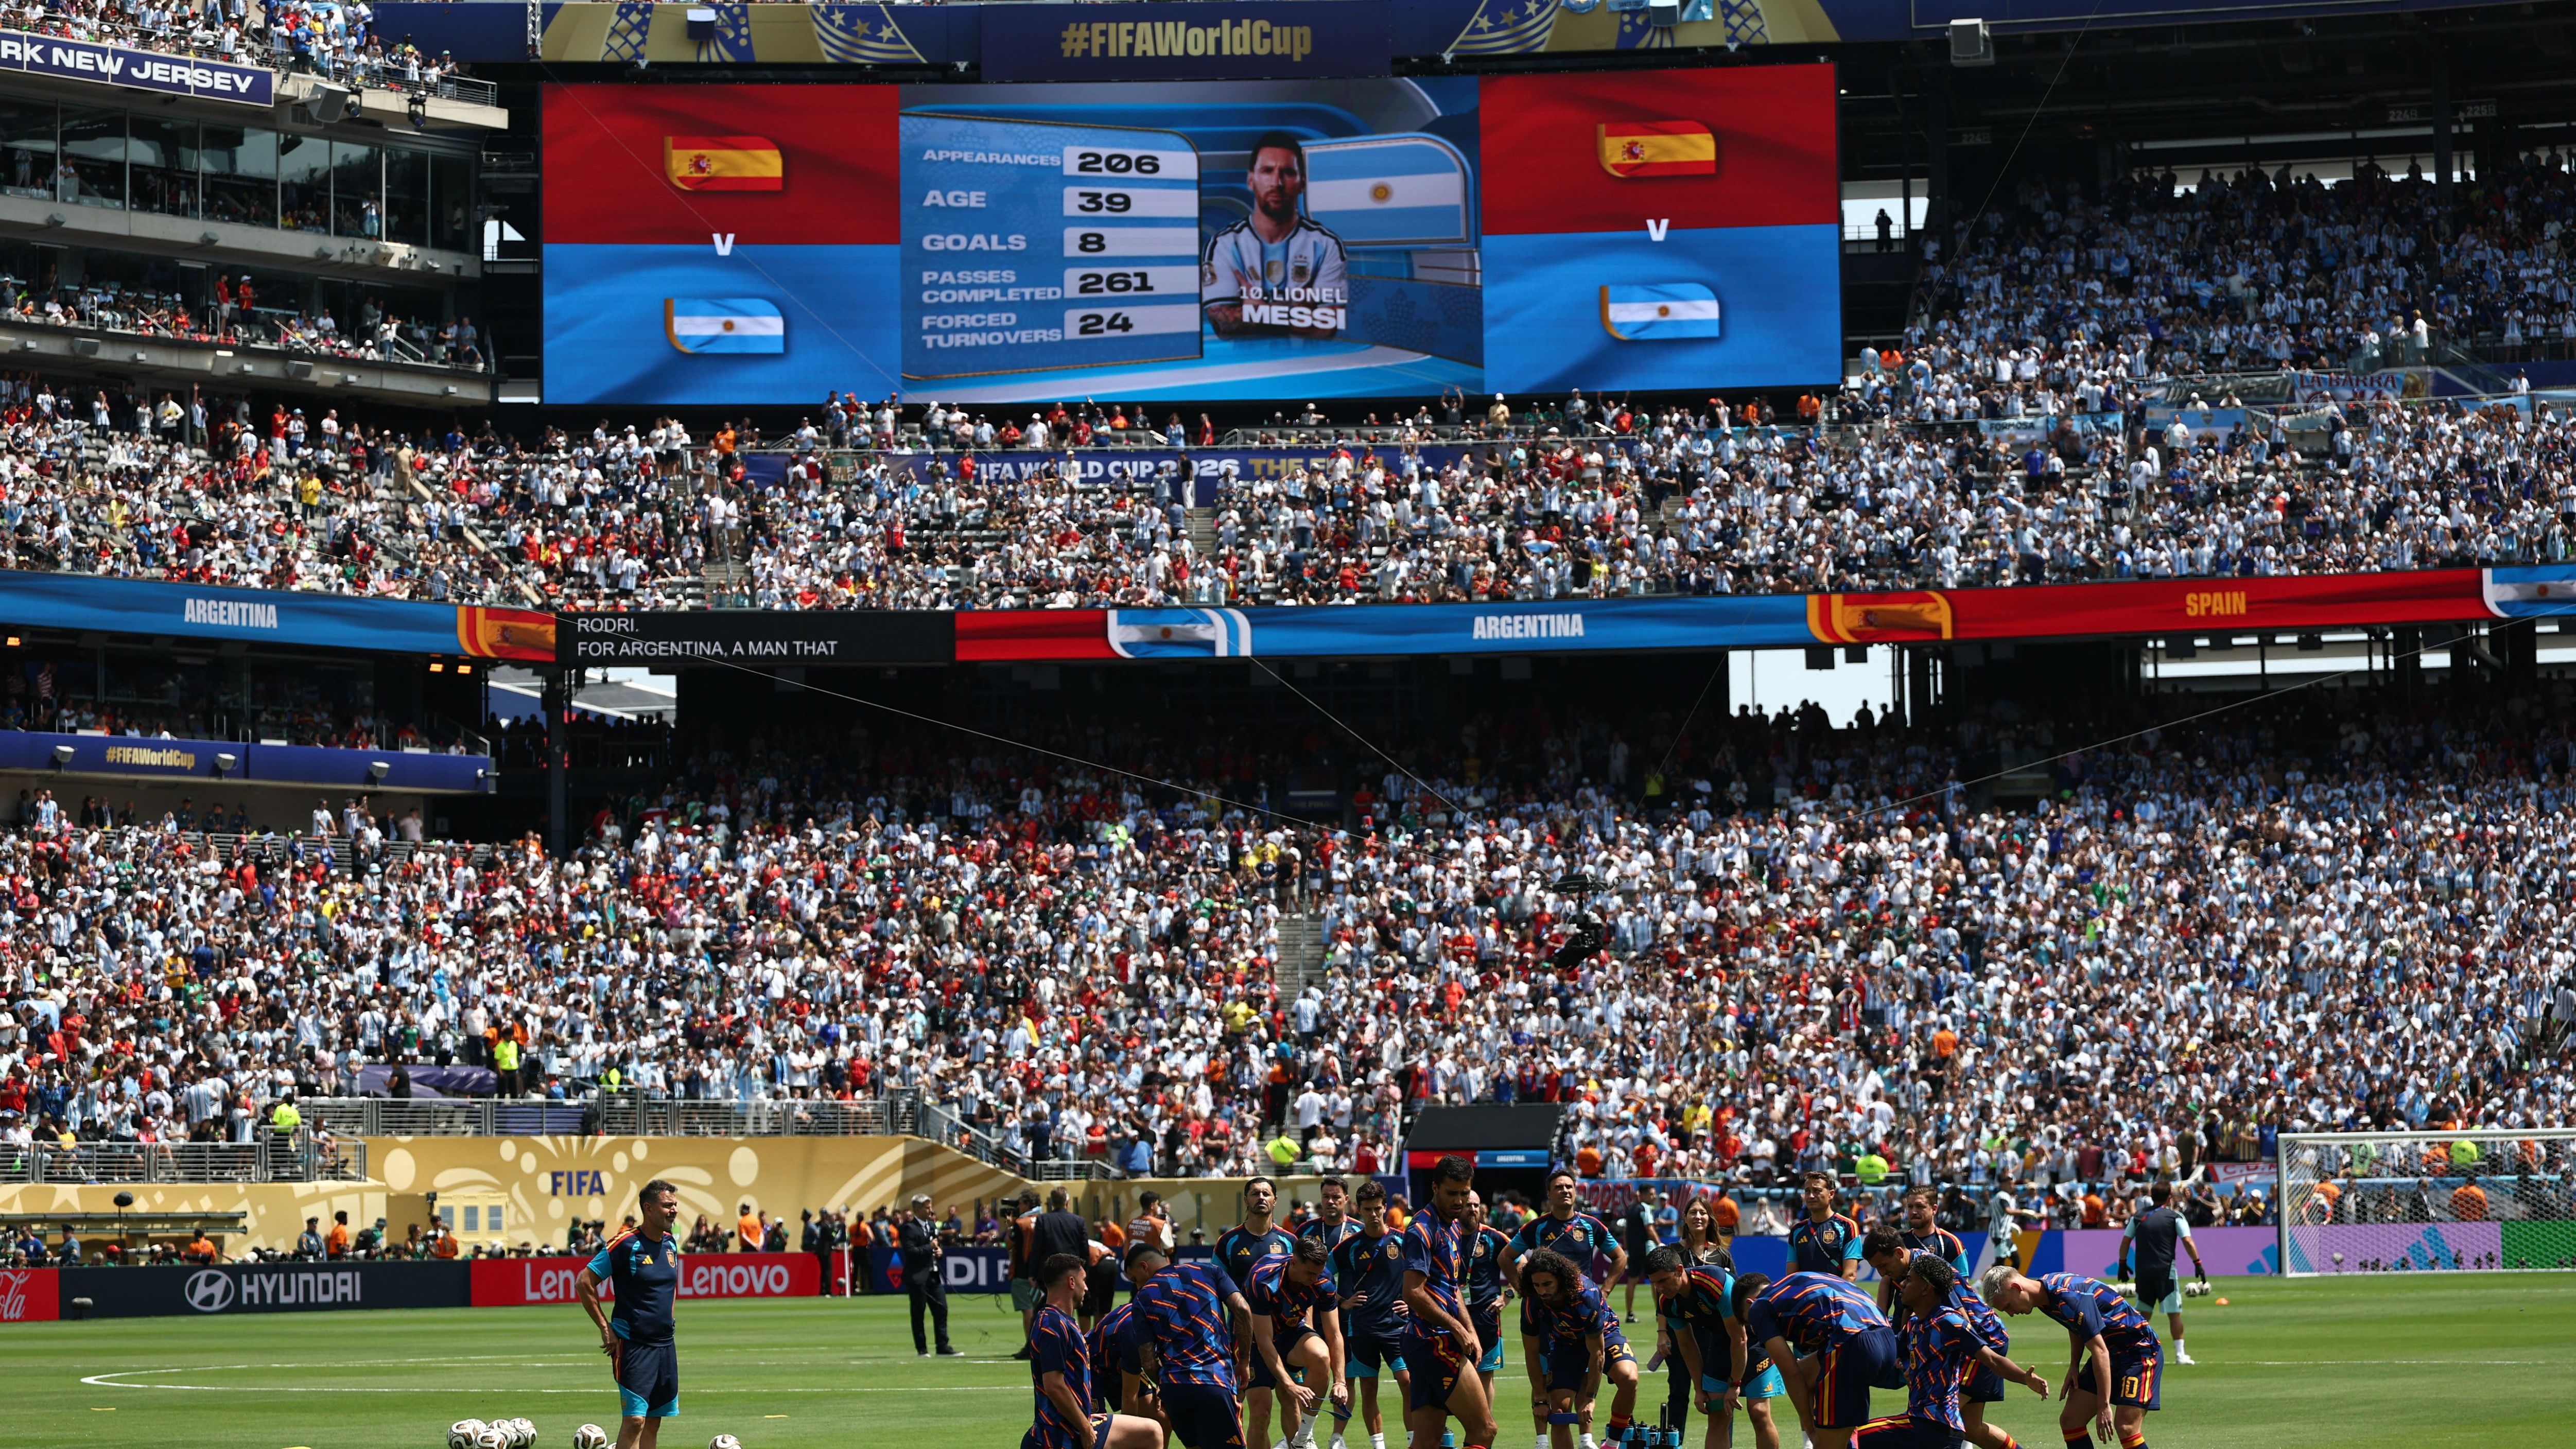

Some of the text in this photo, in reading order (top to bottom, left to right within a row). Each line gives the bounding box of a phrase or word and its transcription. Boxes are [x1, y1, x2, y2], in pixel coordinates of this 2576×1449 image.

[1060, 19, 1312, 61] #FIFAWorldCup
[52, 47, 124, 75] NEW
[131, 60, 254, 93] JERSEY
[923, 150, 1160, 174] APPEARANCES 206
[923, 190, 1132, 213] AGE 39
[922, 233, 1106, 253] GOALS 8
[923, 270, 1154, 294] PASSES 261
[922, 287, 1062, 303] COMPLETED
[1240, 286, 1348, 303] 10. LIONEL
[923, 312, 1134, 335] FORCED 24
[1242, 304, 1346, 330] MESSI
[922, 329, 1062, 348] TURNOVERS
[2300, 374, 2397, 389] LA BARRA
[1019, 461, 1103, 479] WLD
[1108, 460, 1155, 478] CUP
[1248, 458, 1303, 476] THE
[1310, 457, 1384, 476] FIAL
[184, 598, 277, 629] ARGENTINA
[2185, 591, 2246, 617] SPAIN
[578, 618, 639, 632] RODRI.
[1473, 613, 1584, 639] ARGENTINA
[578, 640, 838, 657] FOR ARGENTINA, A MAN THAT
[106, 746, 195, 771] #FIFAWorldCup
[551, 1170, 605, 1196] FIFA
[525, 1259, 789, 1301] Lenv Lenovo
[939, 1256, 987, 1286] DI
[241, 1271, 360, 1305] HYUNDAI
[1608, 1342, 1634, 1359] 24
[2120, 1375, 2138, 1398] 10
